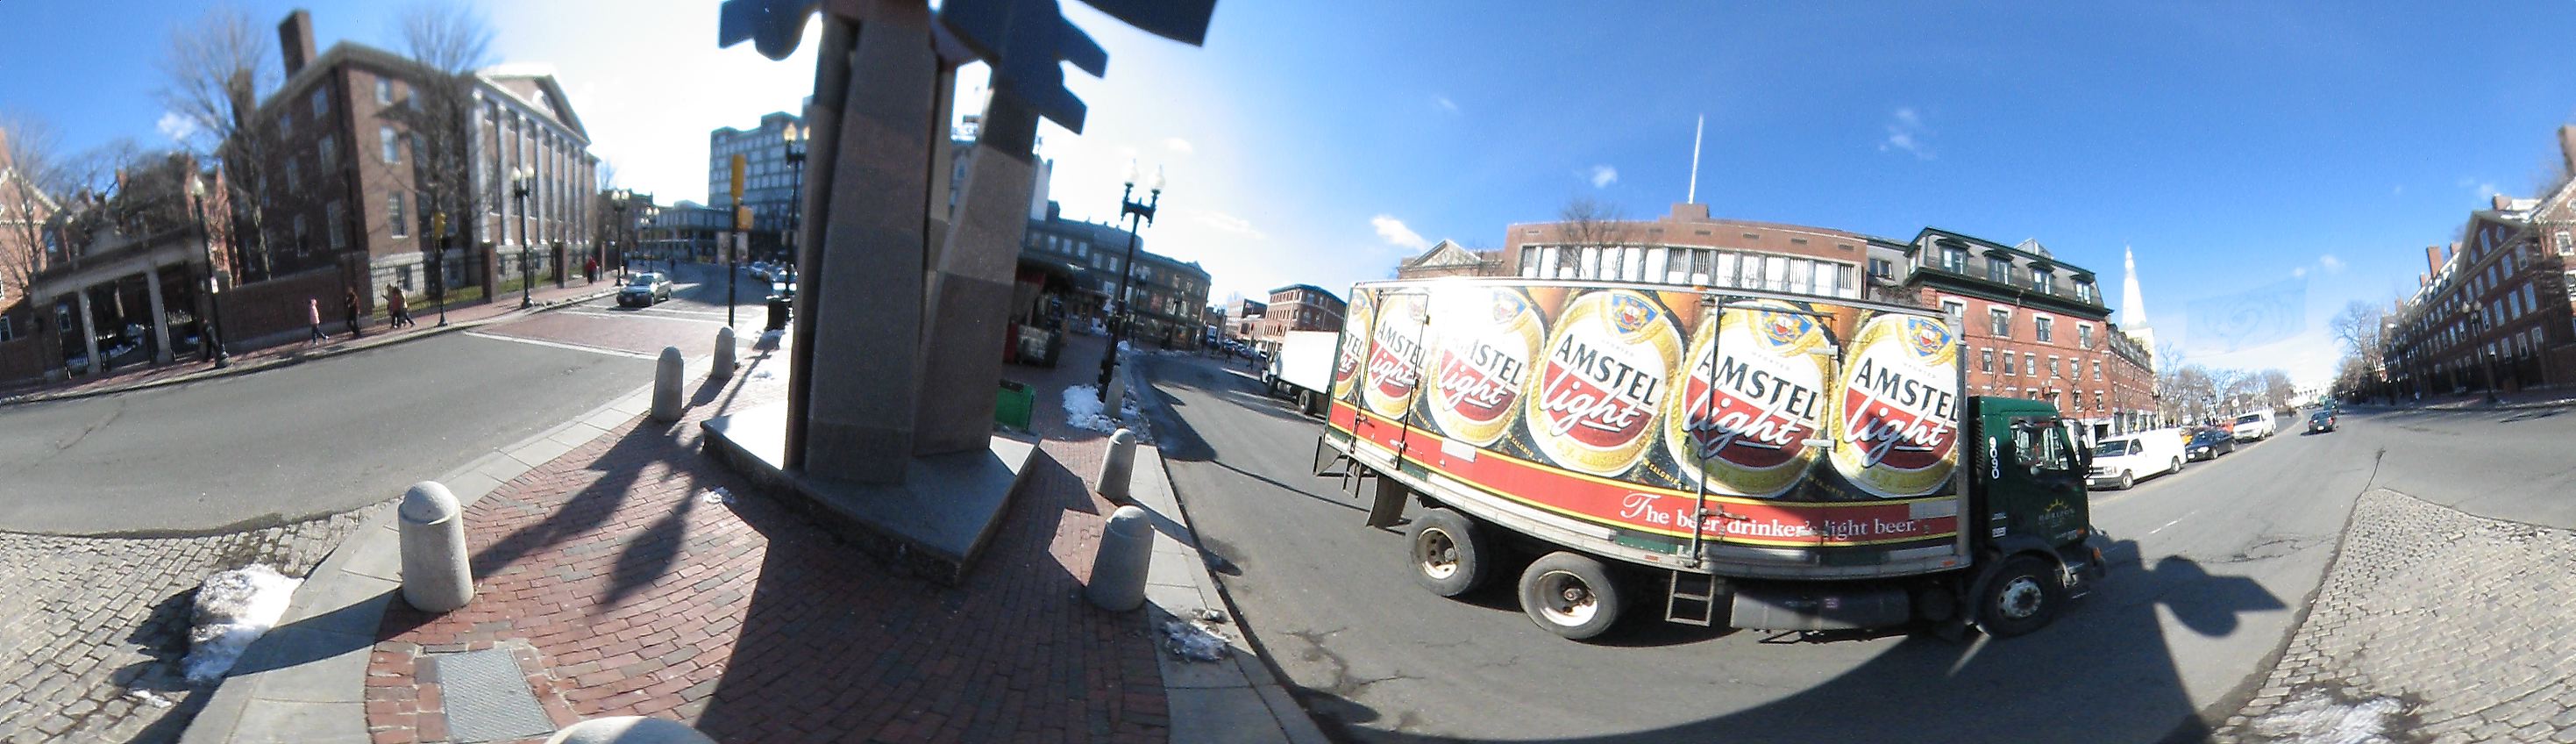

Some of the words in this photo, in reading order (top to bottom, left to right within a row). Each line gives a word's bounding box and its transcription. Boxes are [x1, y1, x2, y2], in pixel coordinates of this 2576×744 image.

[1377, 320, 1427, 369] AMSTEL
[1555, 333, 1659, 406] AMSTEL
[1436, 354, 1507, 411] light
[1539, 368, 1641, 436] light
[1697, 349, 1818, 421] AMSTEL
[1682, 383, 1801, 460] light
[1843, 392, 1948, 469] light
[1620, 491, 1670, 525] The
[1676, 508, 1720, 532] beer
[1875, 518, 1916, 535] beer.
